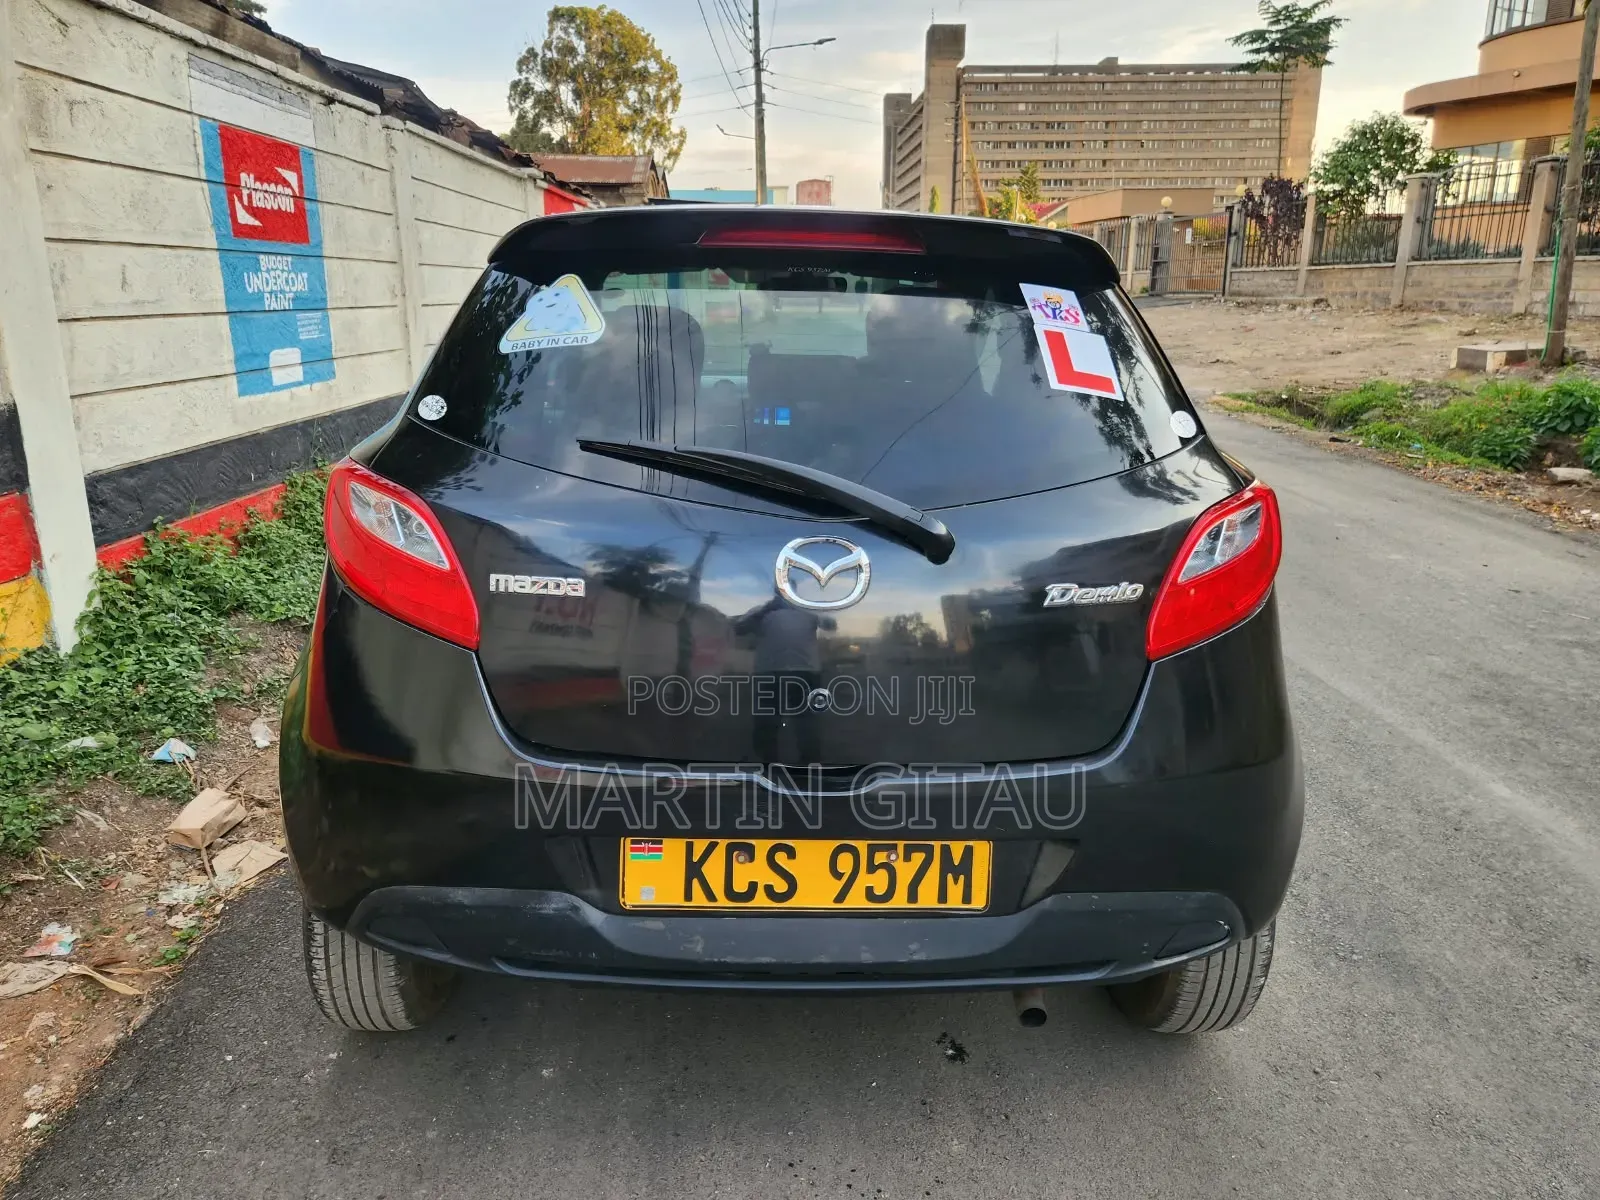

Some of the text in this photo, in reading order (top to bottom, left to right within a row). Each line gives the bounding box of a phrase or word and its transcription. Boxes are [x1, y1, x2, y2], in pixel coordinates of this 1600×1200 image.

[240, 172, 295, 214] Plascon
[260, 255, 292, 271] BUDGET
[243, 270, 308, 293] UNDERCOAT
[264, 292, 294, 311] PAINT
[511, 336, 588, 350] BABY IN CAR
[1043, 330, 1116, 394] L
[1043, 582, 1144, 607] Demio
[683, 841, 797, 903] KCS
[828, 843, 974, 904] 957M
